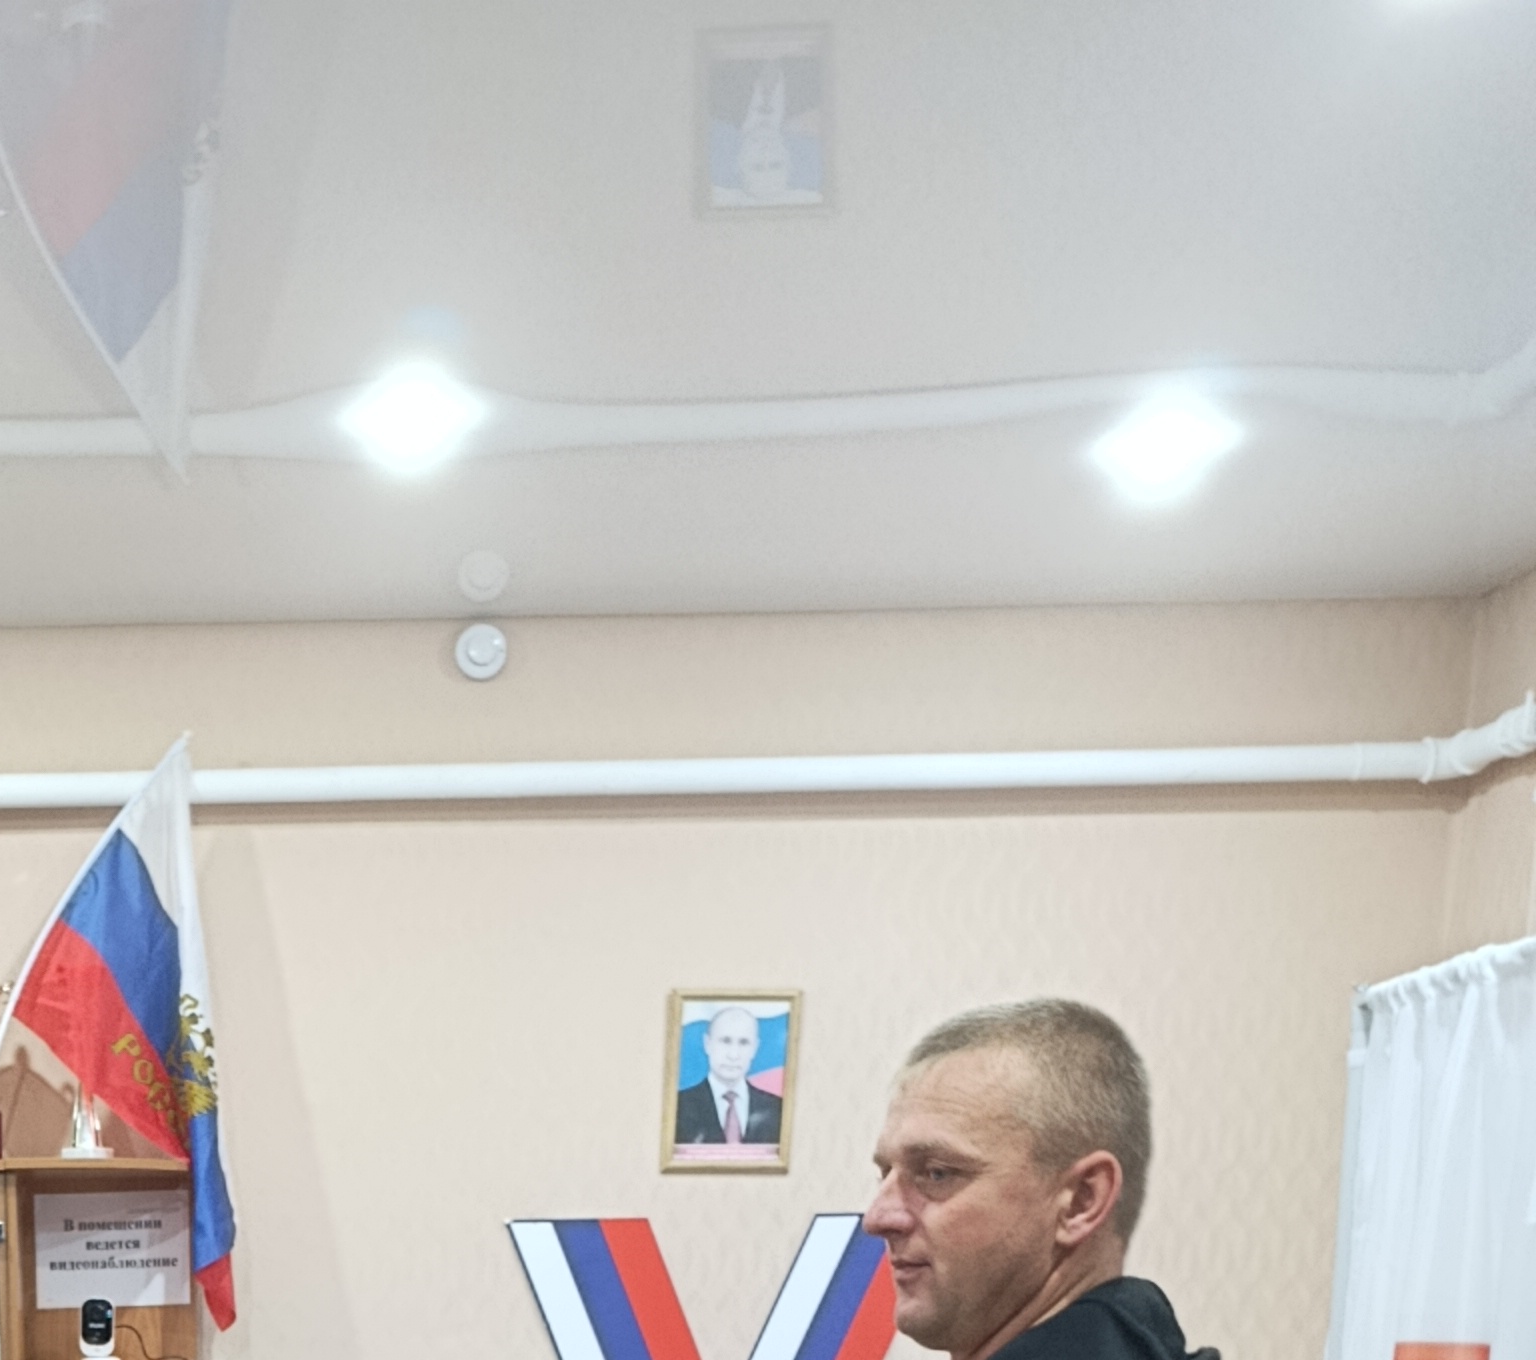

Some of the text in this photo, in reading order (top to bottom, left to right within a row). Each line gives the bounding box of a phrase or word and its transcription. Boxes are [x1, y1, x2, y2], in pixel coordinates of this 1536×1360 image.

[63, 1219, 162, 1232] В помещении
[85, 1239, 141, 1251] ведется
[49, 1257, 178, 1271] видеонаблюдение
